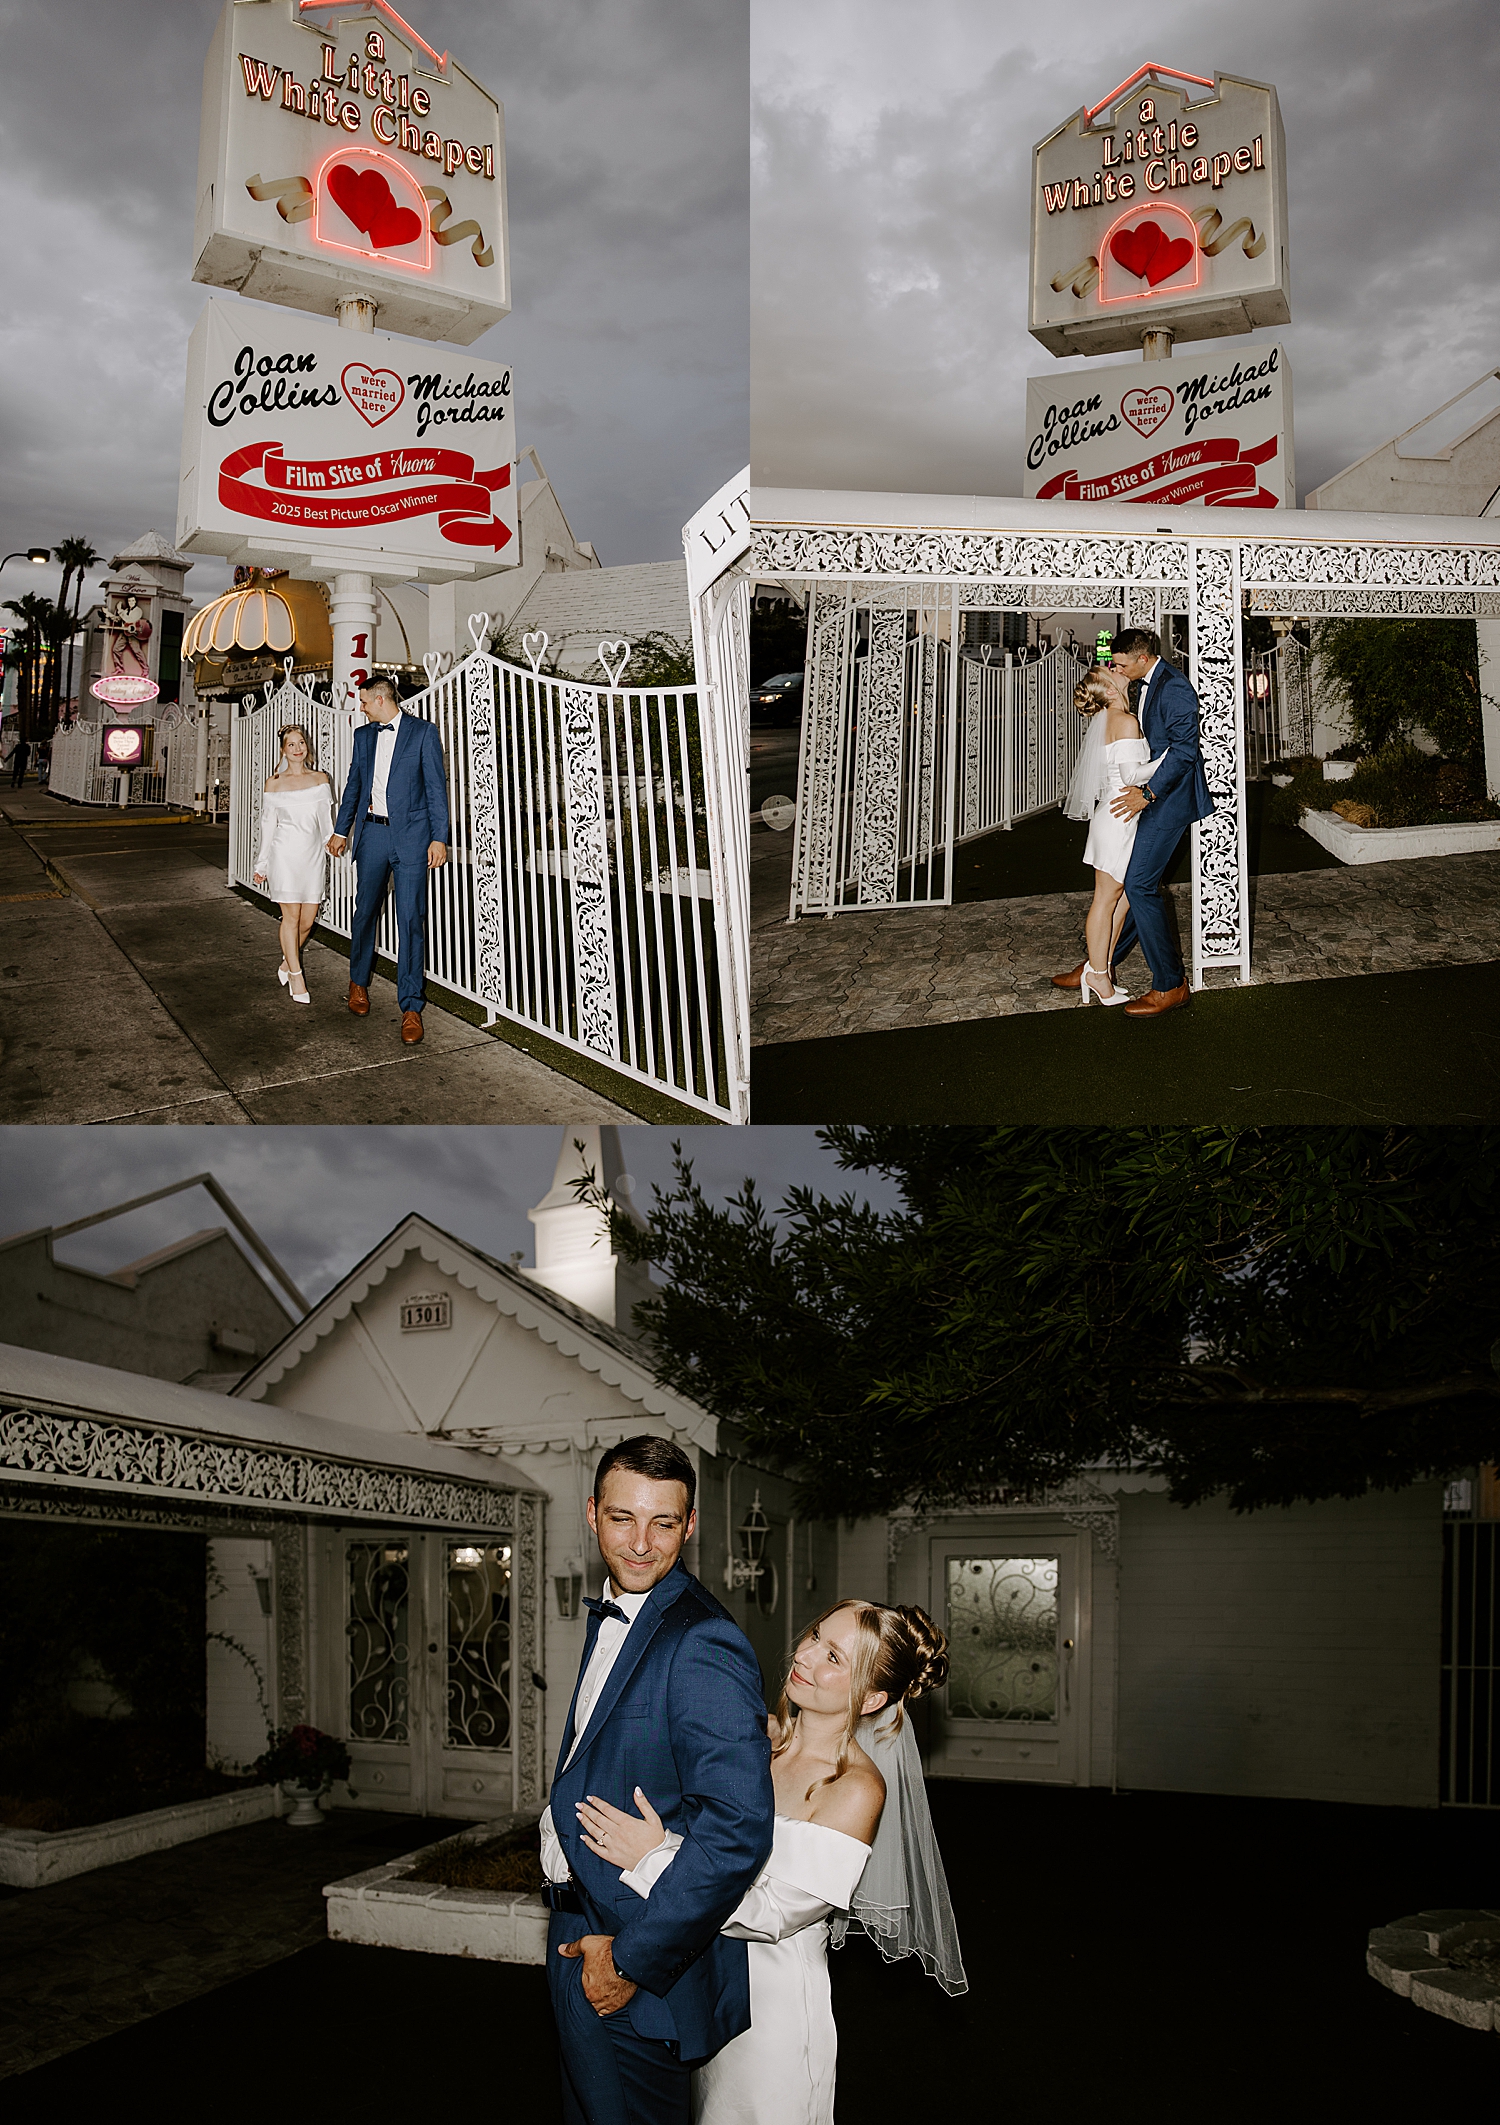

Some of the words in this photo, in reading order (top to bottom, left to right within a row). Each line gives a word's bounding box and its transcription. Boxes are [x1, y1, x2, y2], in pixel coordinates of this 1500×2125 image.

[366, 31, 386, 63] a
[320, 43, 431, 117] Little
[237, 53, 361, 132] White
[371, 105, 495, 181] Chapel
[1139, 98, 1157, 125] a
[1101, 119, 1199, 169] Little
[1042, 171, 1136, 216] White
[1144, 134, 1265, 193] Chapel
[234, 346, 318, 393] Joan
[360, 374, 387, 389] were
[1176, 348, 1279, 405] Michael
[351, 386, 396, 403] married
[407, 370, 511, 402] Michael
[1136, 395, 1159, 406] were
[207, 378, 342, 427] Collins
[361, 398, 386, 413] here
[1043, 393, 1103, 441] Joan
[1129, 404, 1167, 417] married
[1184, 384, 1273, 436] Jordan
[416, 401, 506, 438] Jordan
[1137, 415, 1158, 426] here
[1026, 413, 1121, 471] Collins
[286, 465, 326, 488] Film
[329, 465, 363, 486] Site
[366, 457, 383, 478] of
[1079, 484, 1109, 501] Film
[1112, 472, 1139, 494] Site
[1140, 461, 1155, 481] of
[1169, 479, 1205, 499] Winner
[271, 502, 301, 518] 2025
[304, 507, 329, 520] Best
[330, 506, 370, 521] Picture
[370, 501, 401, 517] Oscar
[399, 492, 438, 510] Winner
[407, 1306, 441, 1325] 1301
